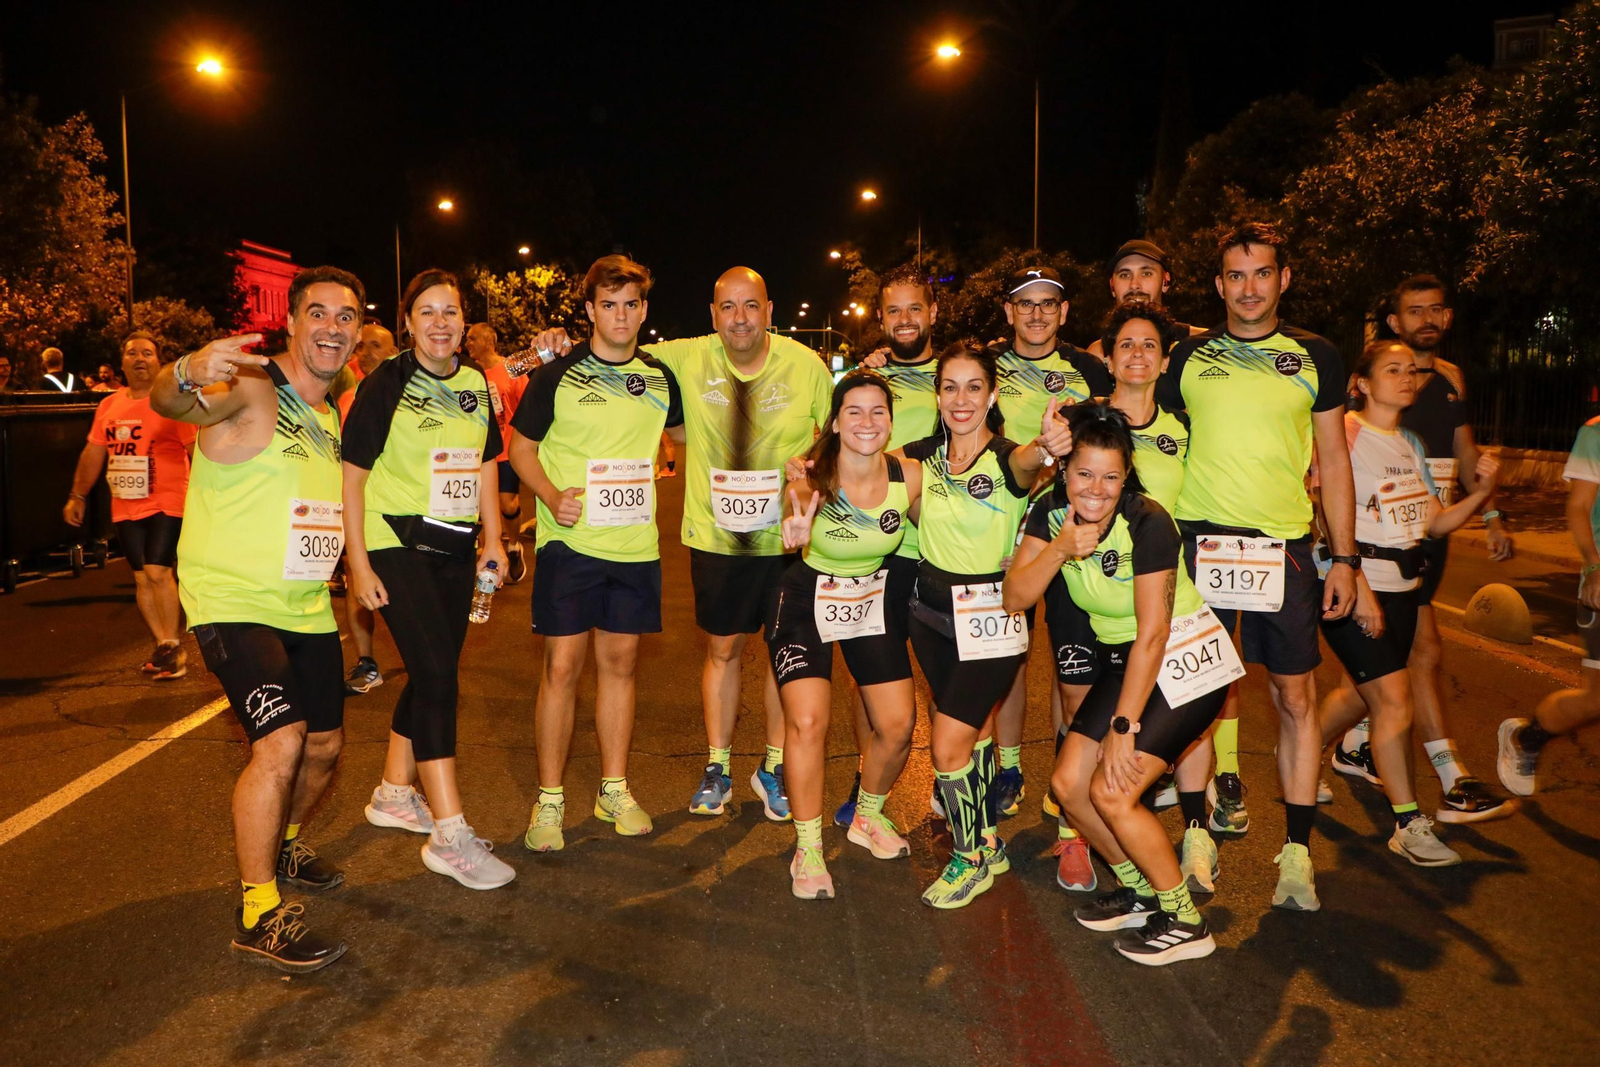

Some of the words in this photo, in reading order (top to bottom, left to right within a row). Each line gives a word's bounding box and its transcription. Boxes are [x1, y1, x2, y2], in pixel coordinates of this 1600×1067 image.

[442, 479, 477, 499] 4251
[599, 488, 645, 507] 3038
[720, 497, 770, 515] 3037
[299, 535, 339, 558] 3039
[1209, 568, 1270, 591] 3197
[825, 600, 874, 622] 3337
[969, 613, 1023, 638] 3078
[1166, 638, 1222, 681] 3047
